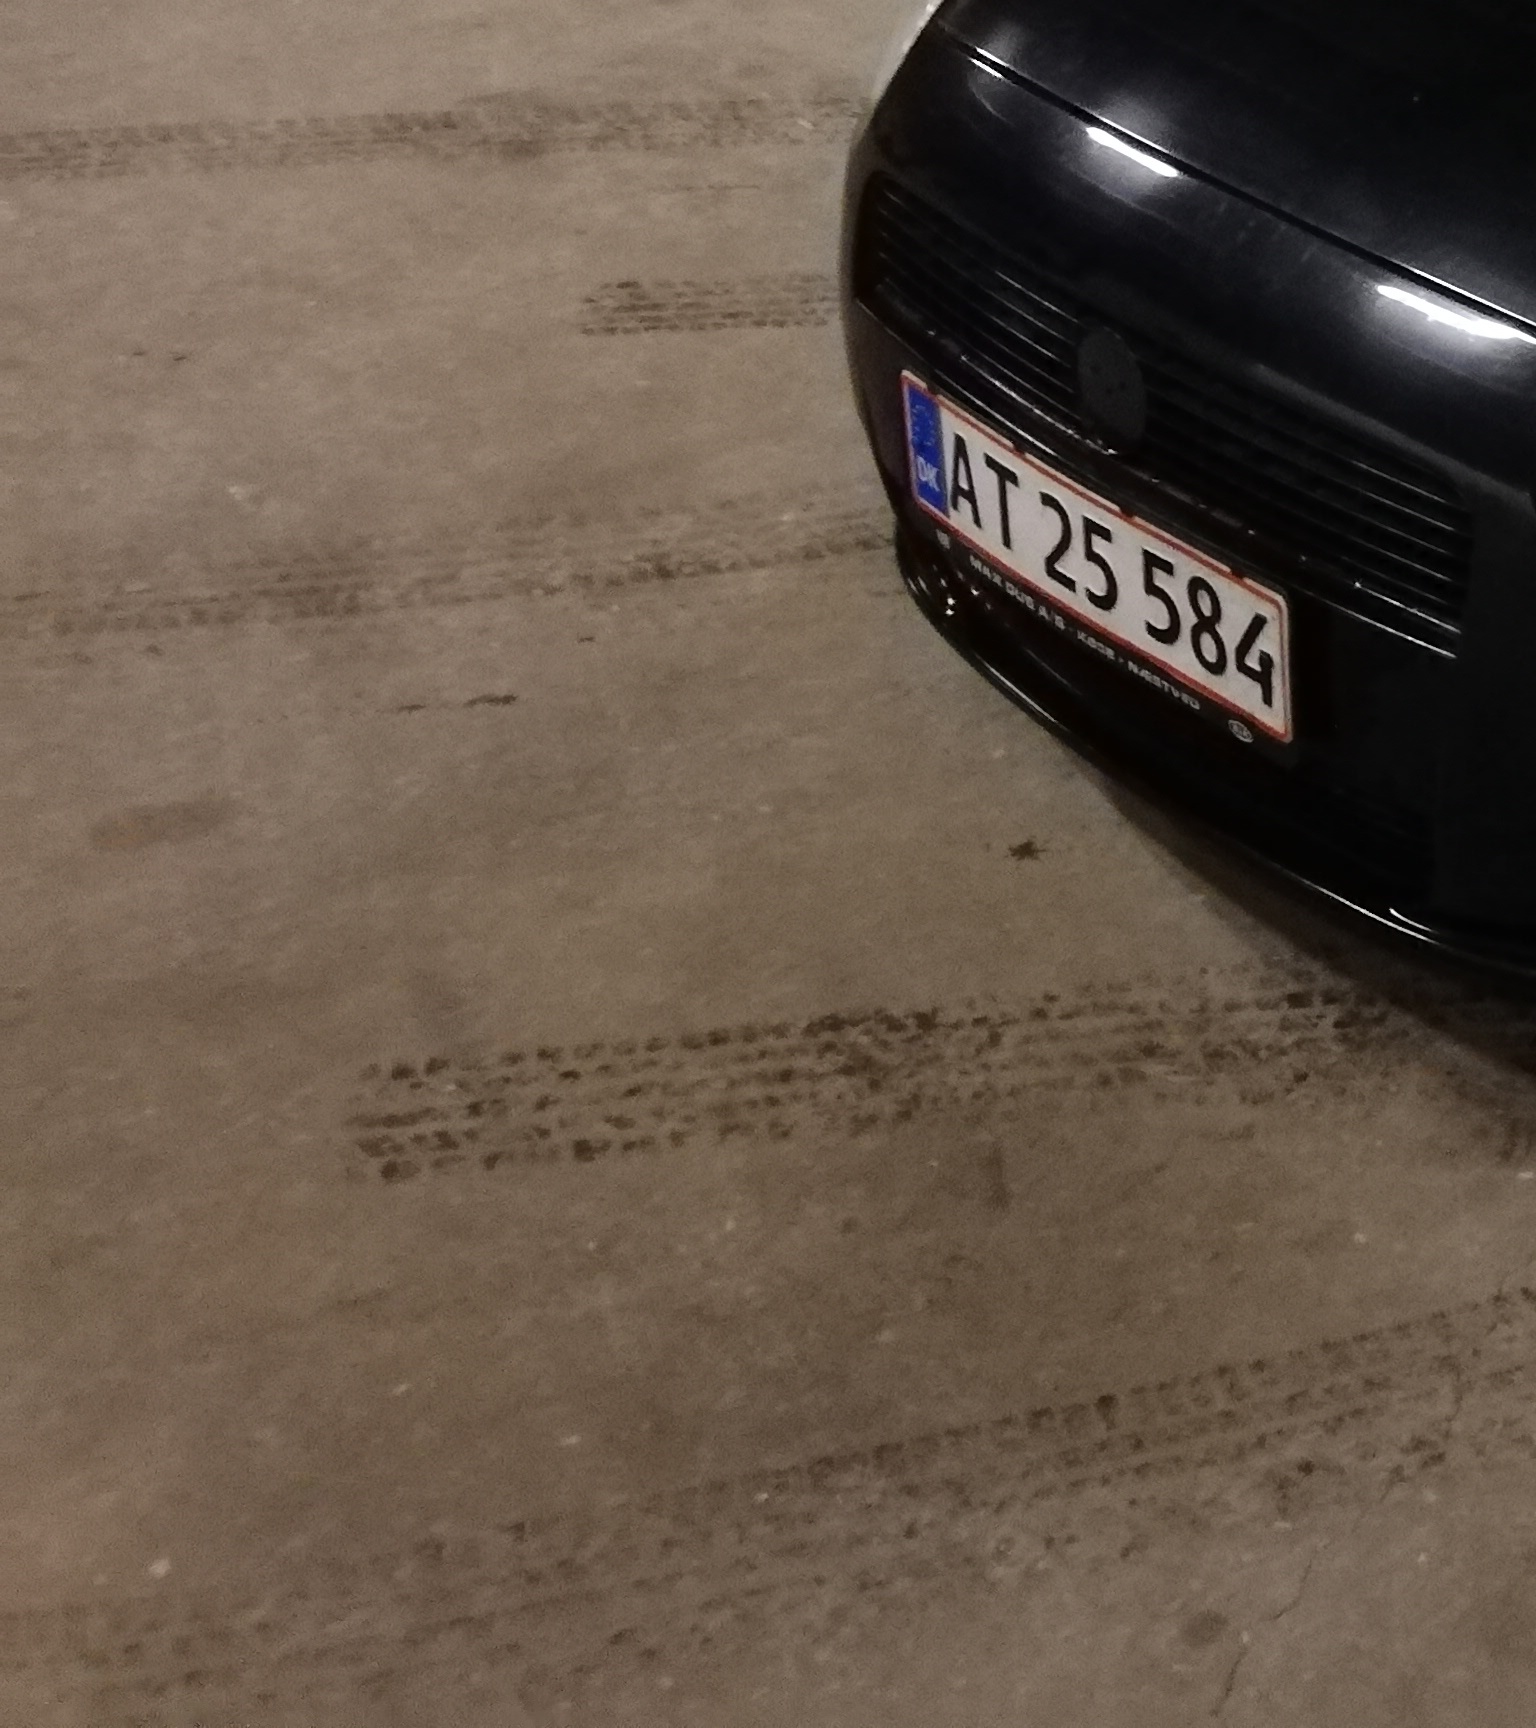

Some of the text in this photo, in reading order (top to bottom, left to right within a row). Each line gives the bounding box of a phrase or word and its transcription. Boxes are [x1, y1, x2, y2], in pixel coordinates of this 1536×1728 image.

[916, 455, 940, 492] DK
[951, 432, 1275, 708] AT 25 584
